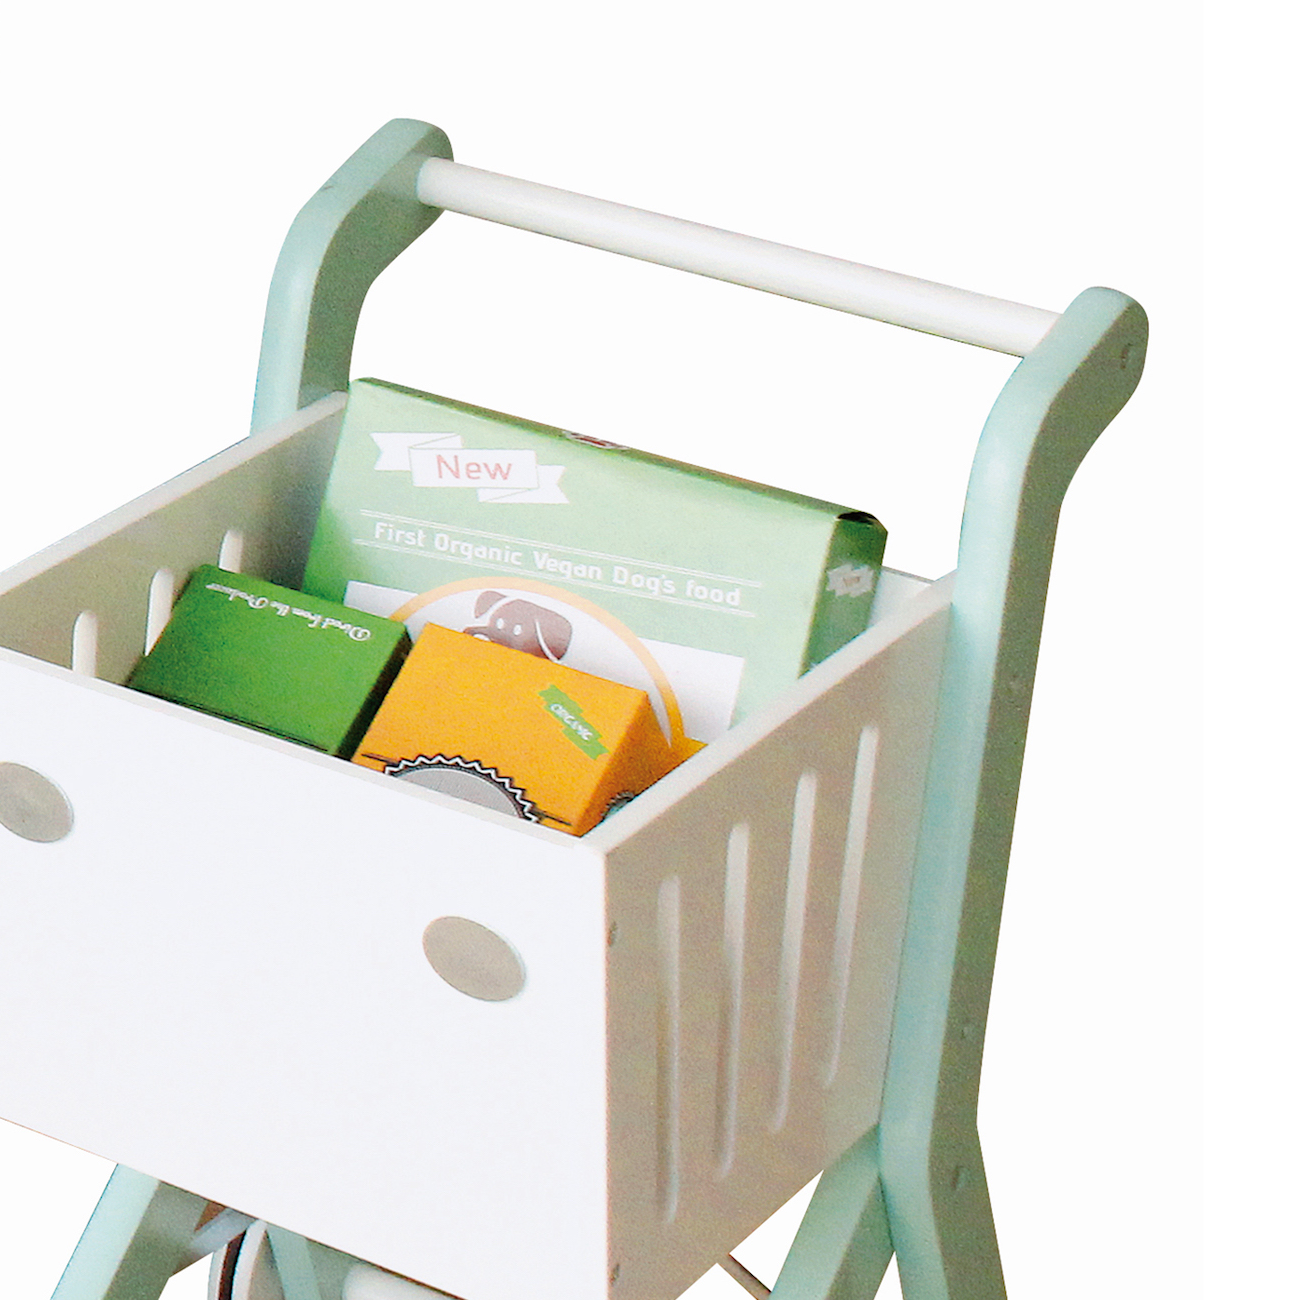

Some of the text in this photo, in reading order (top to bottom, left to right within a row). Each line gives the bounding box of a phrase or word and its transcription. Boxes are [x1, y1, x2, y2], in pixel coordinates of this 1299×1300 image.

[436, 454, 512, 481] New
[374, 521, 741, 607] First Organic Vegan Dog's food
